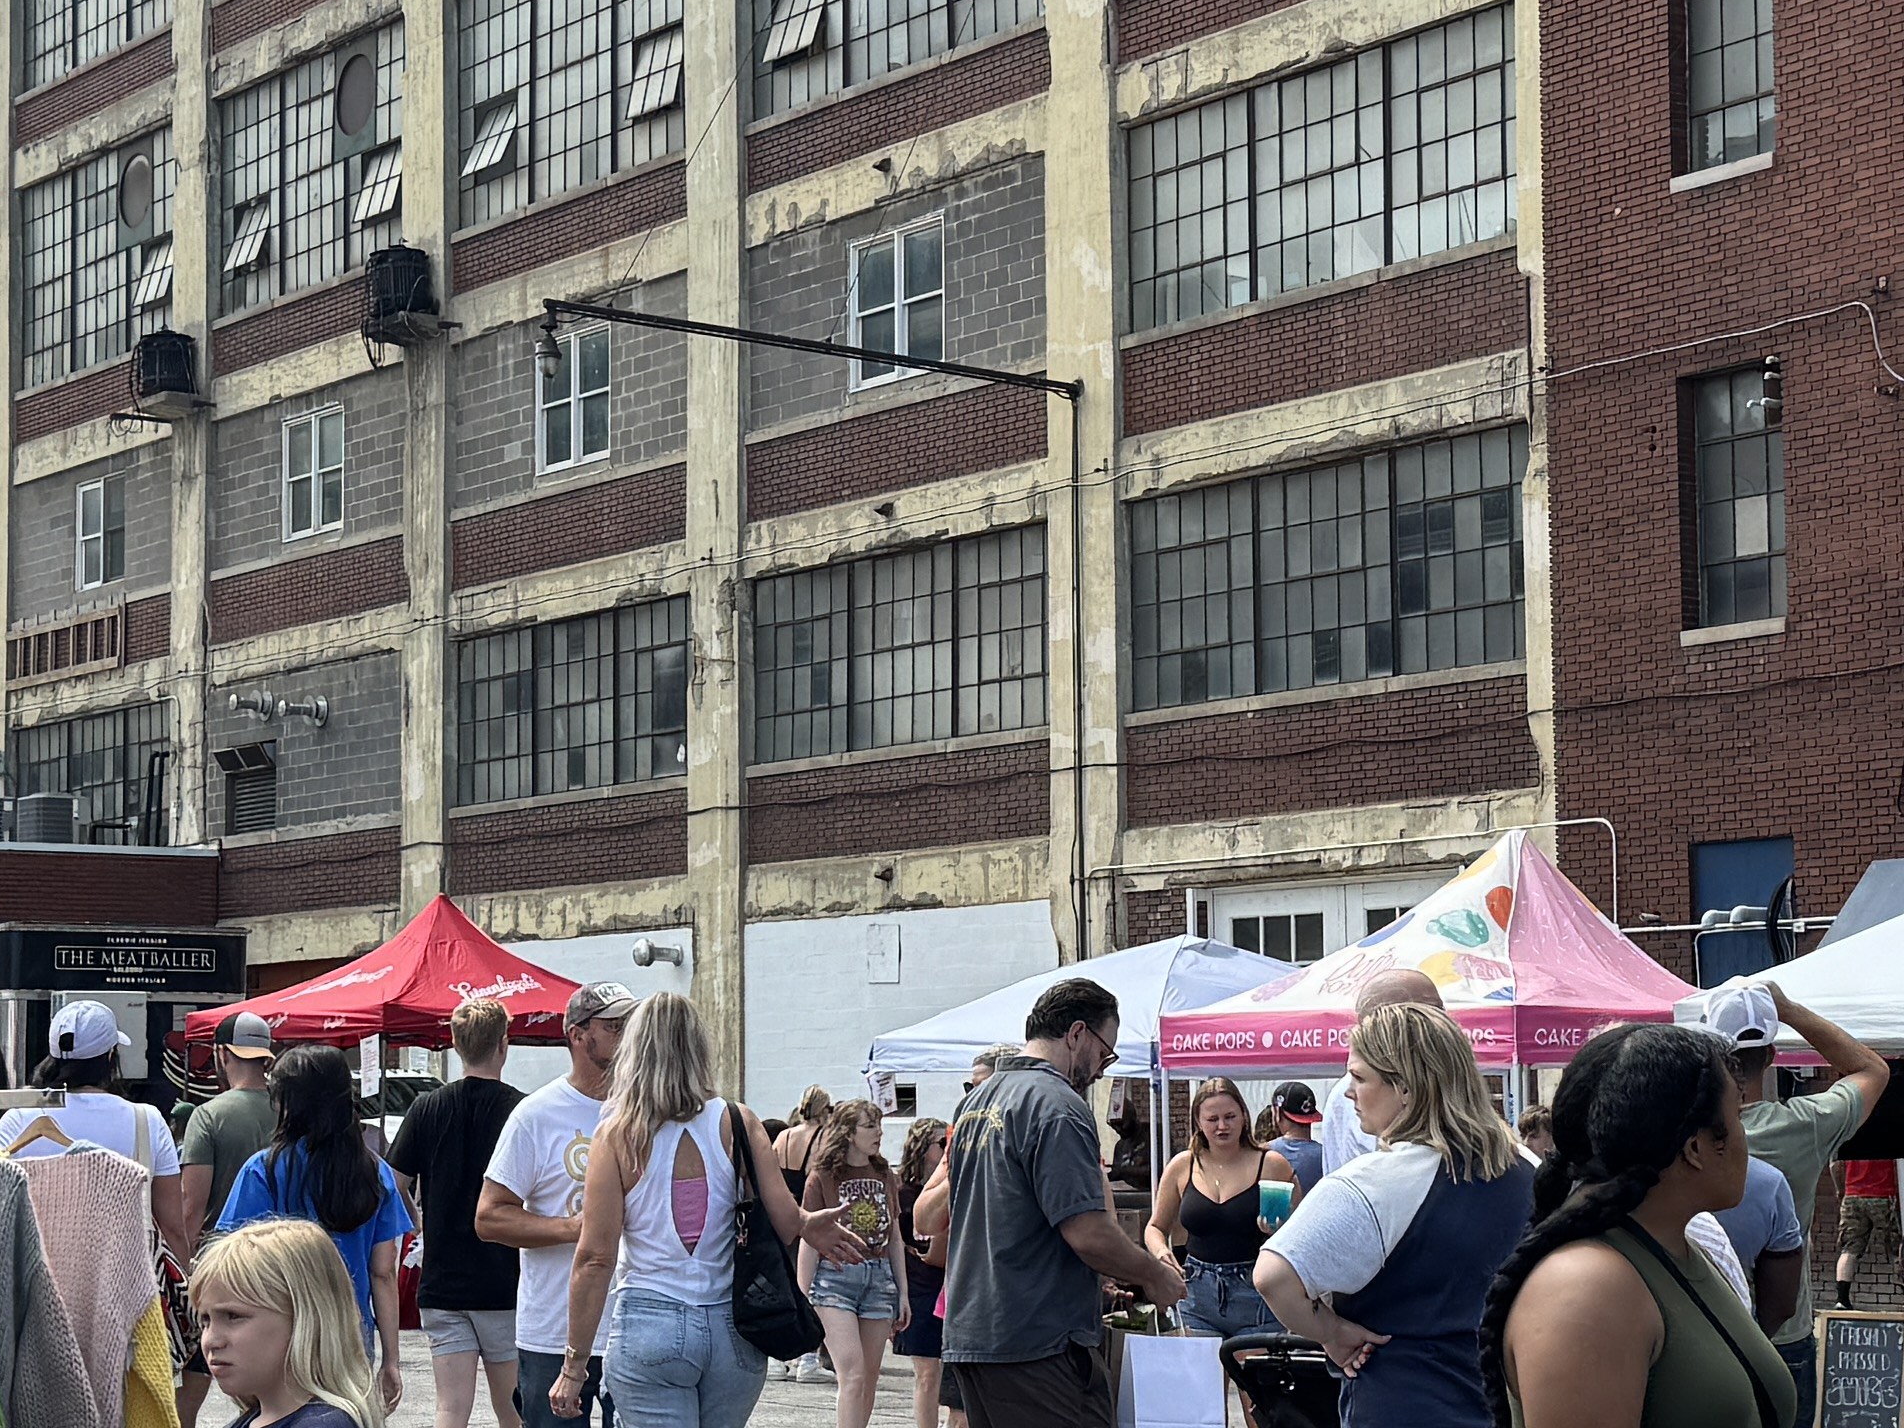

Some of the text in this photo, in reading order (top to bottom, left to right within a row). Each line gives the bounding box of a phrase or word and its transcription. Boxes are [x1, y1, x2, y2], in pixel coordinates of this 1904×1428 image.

[57, 949, 212, 968] THE MEATBALLER
[1172, 1033, 1211, 1052] CAKE
[1215, 1032, 1255, 1050] POPS
[1280, 1029, 1323, 1048] CAKE
[1534, 1028, 1582, 1046] CAKE
[1839, 1326, 1887, 1348] FRESHLY
[1838, 1351, 1891, 1371] PRESSED
